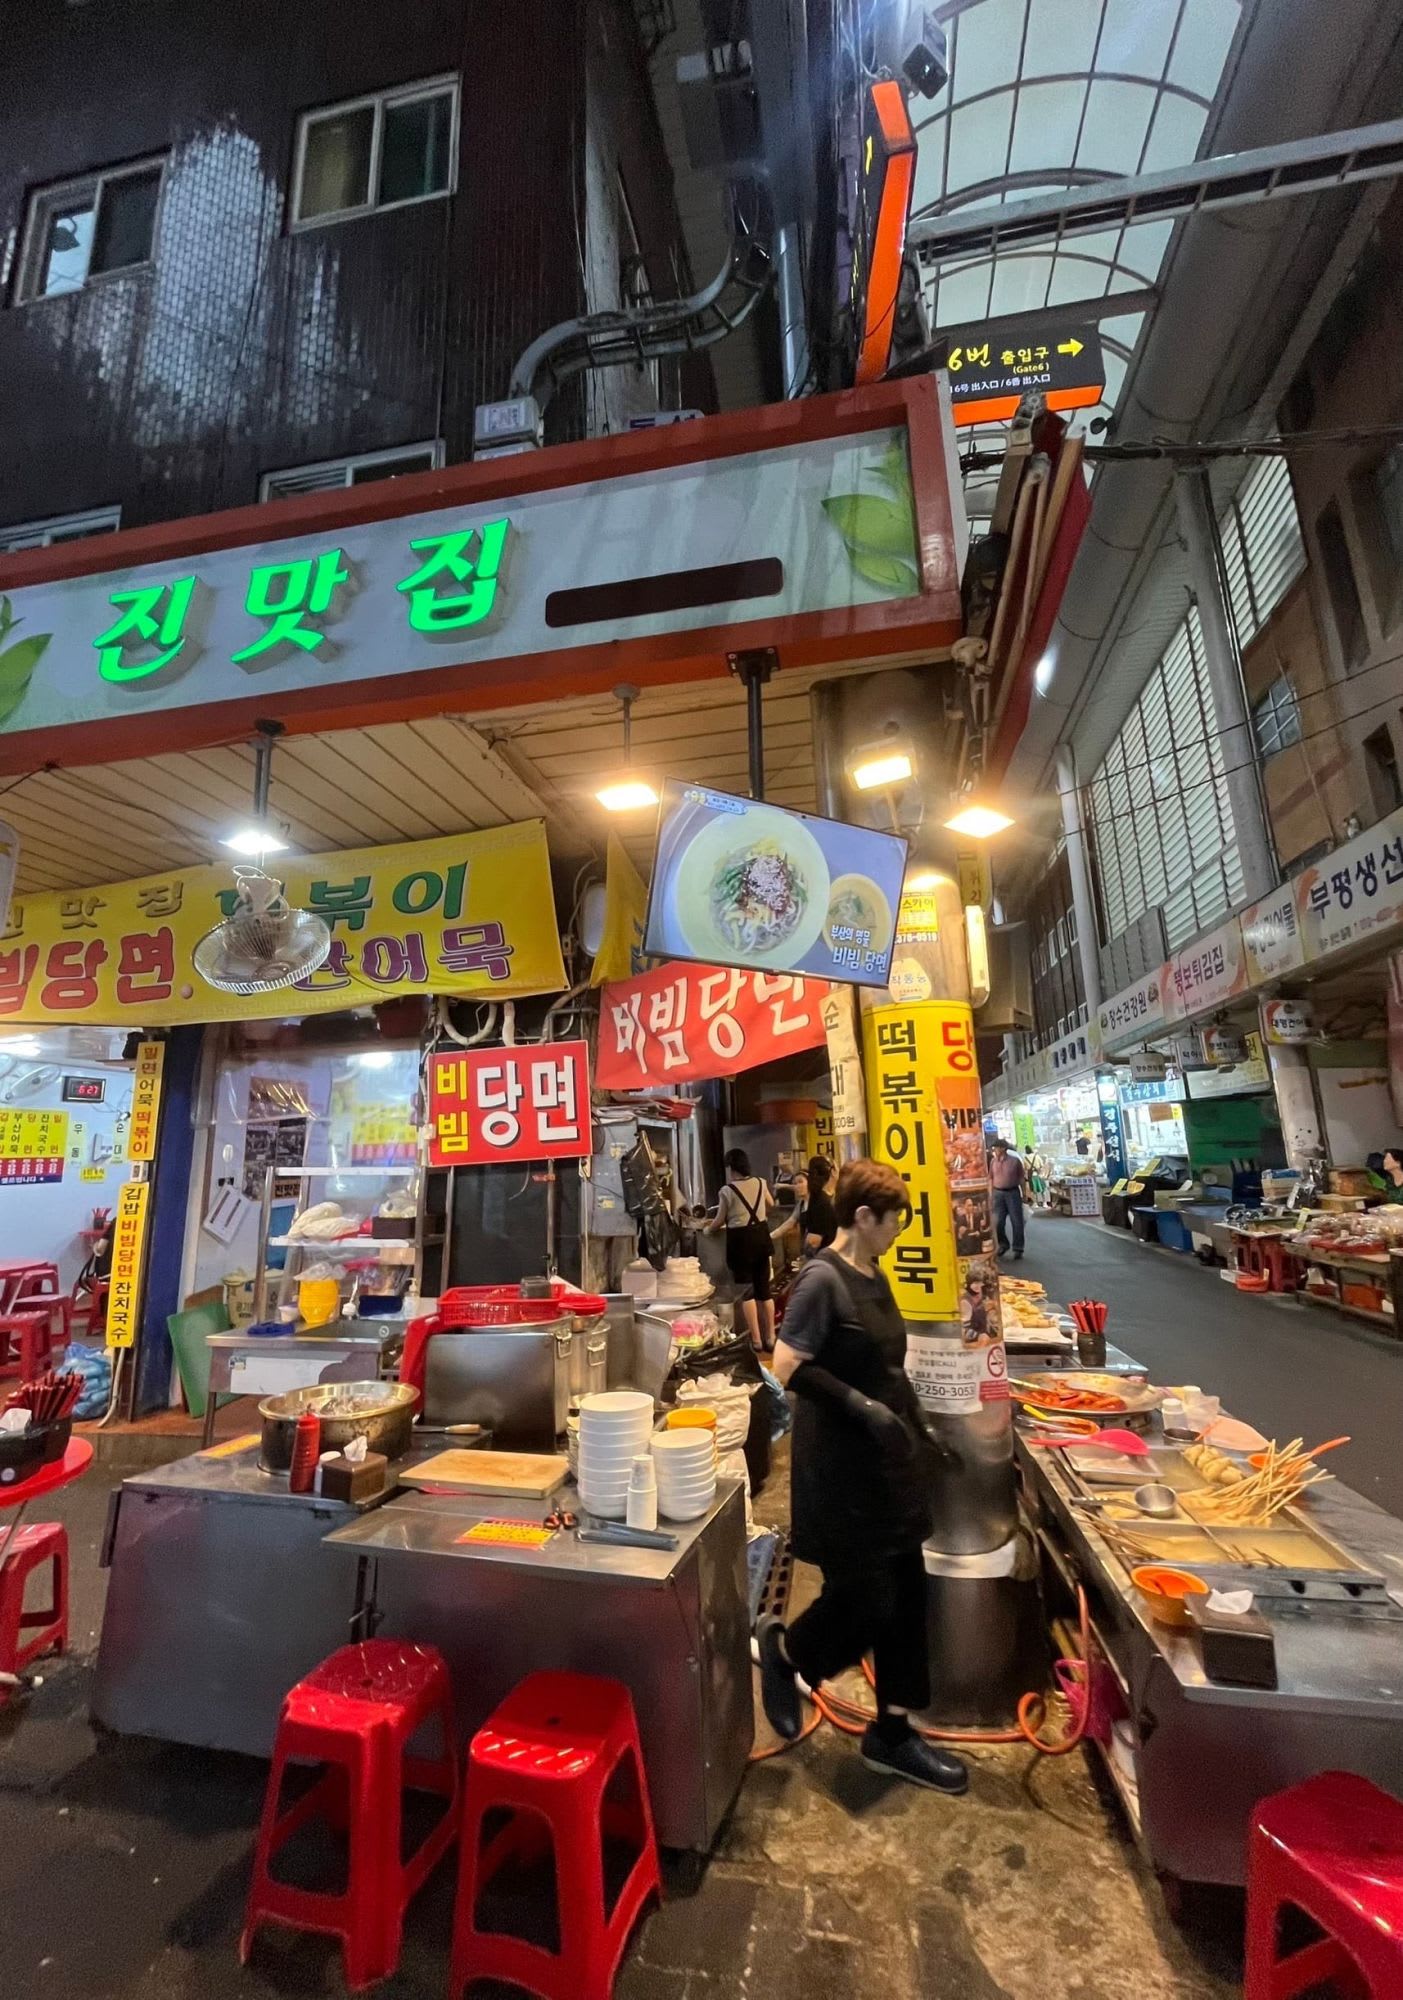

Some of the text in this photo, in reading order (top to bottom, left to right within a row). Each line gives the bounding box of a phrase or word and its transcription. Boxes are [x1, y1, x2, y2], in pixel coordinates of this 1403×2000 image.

[948, 343, 1049, 371] 6번 출입구
[833, 946, 887, 973] 비빔 당면
[1109, 990, 1147, 1030] 장수건강원
[137, 1079, 156, 1107] 어묵
[437, 1055, 579, 1153] 비빔 당면
[132, 1111, 152, 1154] 떡볶이
[111, 1186, 145, 1341] 김밥 비빔당면 잔치국수
